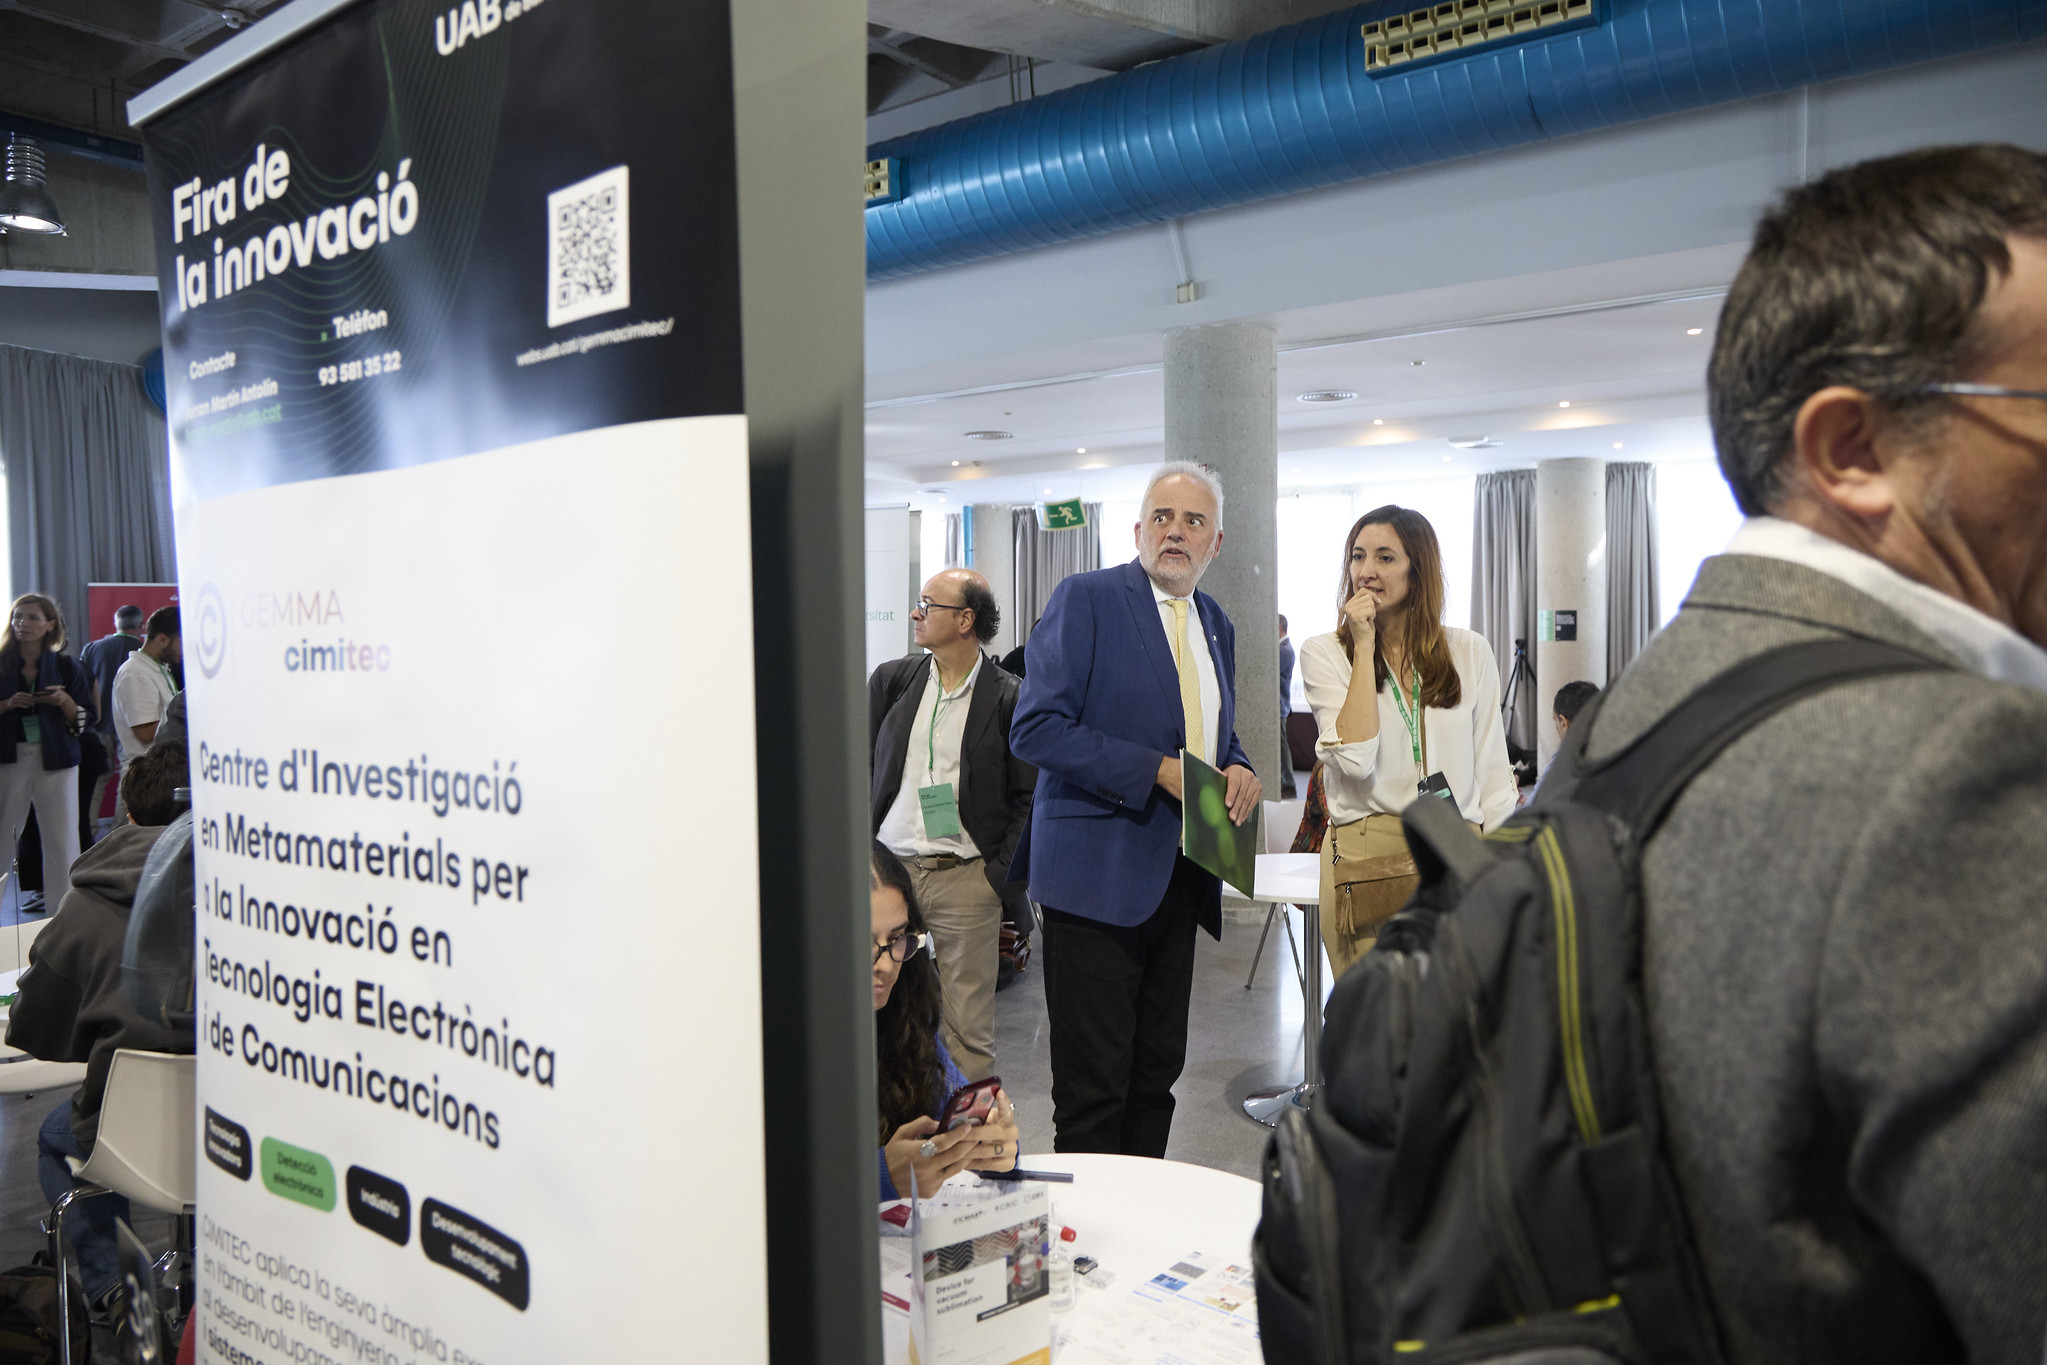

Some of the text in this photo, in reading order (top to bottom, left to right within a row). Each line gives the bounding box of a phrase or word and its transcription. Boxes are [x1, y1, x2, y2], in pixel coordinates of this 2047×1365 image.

[436, 0, 502, 56] UAB
[172, 143, 290, 244] Fira de
[176, 157, 419, 312] la innovació
[332, 308, 388, 339] Telèfon
[189, 350, 236, 380] Contacte
[318, 350, 402, 386] 93 581 35 22
[240, 589, 345, 628] GEMMA
[284, 637, 392, 672] cimitec
[200, 740, 522, 818] Centre d'Investigació
[202, 811, 529, 906] en Metamaterials per
[214, 876, 232, 922] la
[240, 883, 398, 954] Innovació
[411, 925, 452, 967] en
[204, 936, 555, 1088] Tecnologia Electrònica
[210, 1011, 234, 1057] de
[242, 1024, 500, 1149] Comunicacions
[256, 1252, 311, 1290] aplica
[315, 1269, 331, 1300] la
[335, 1286, 377, 1325] seva
[382, 1303, 447, 1363] àmplia
[271, 1291, 295, 1320] de
[935, 1276, 975, 1295] Device for
[936, 1294, 984, 1316] sublimation
